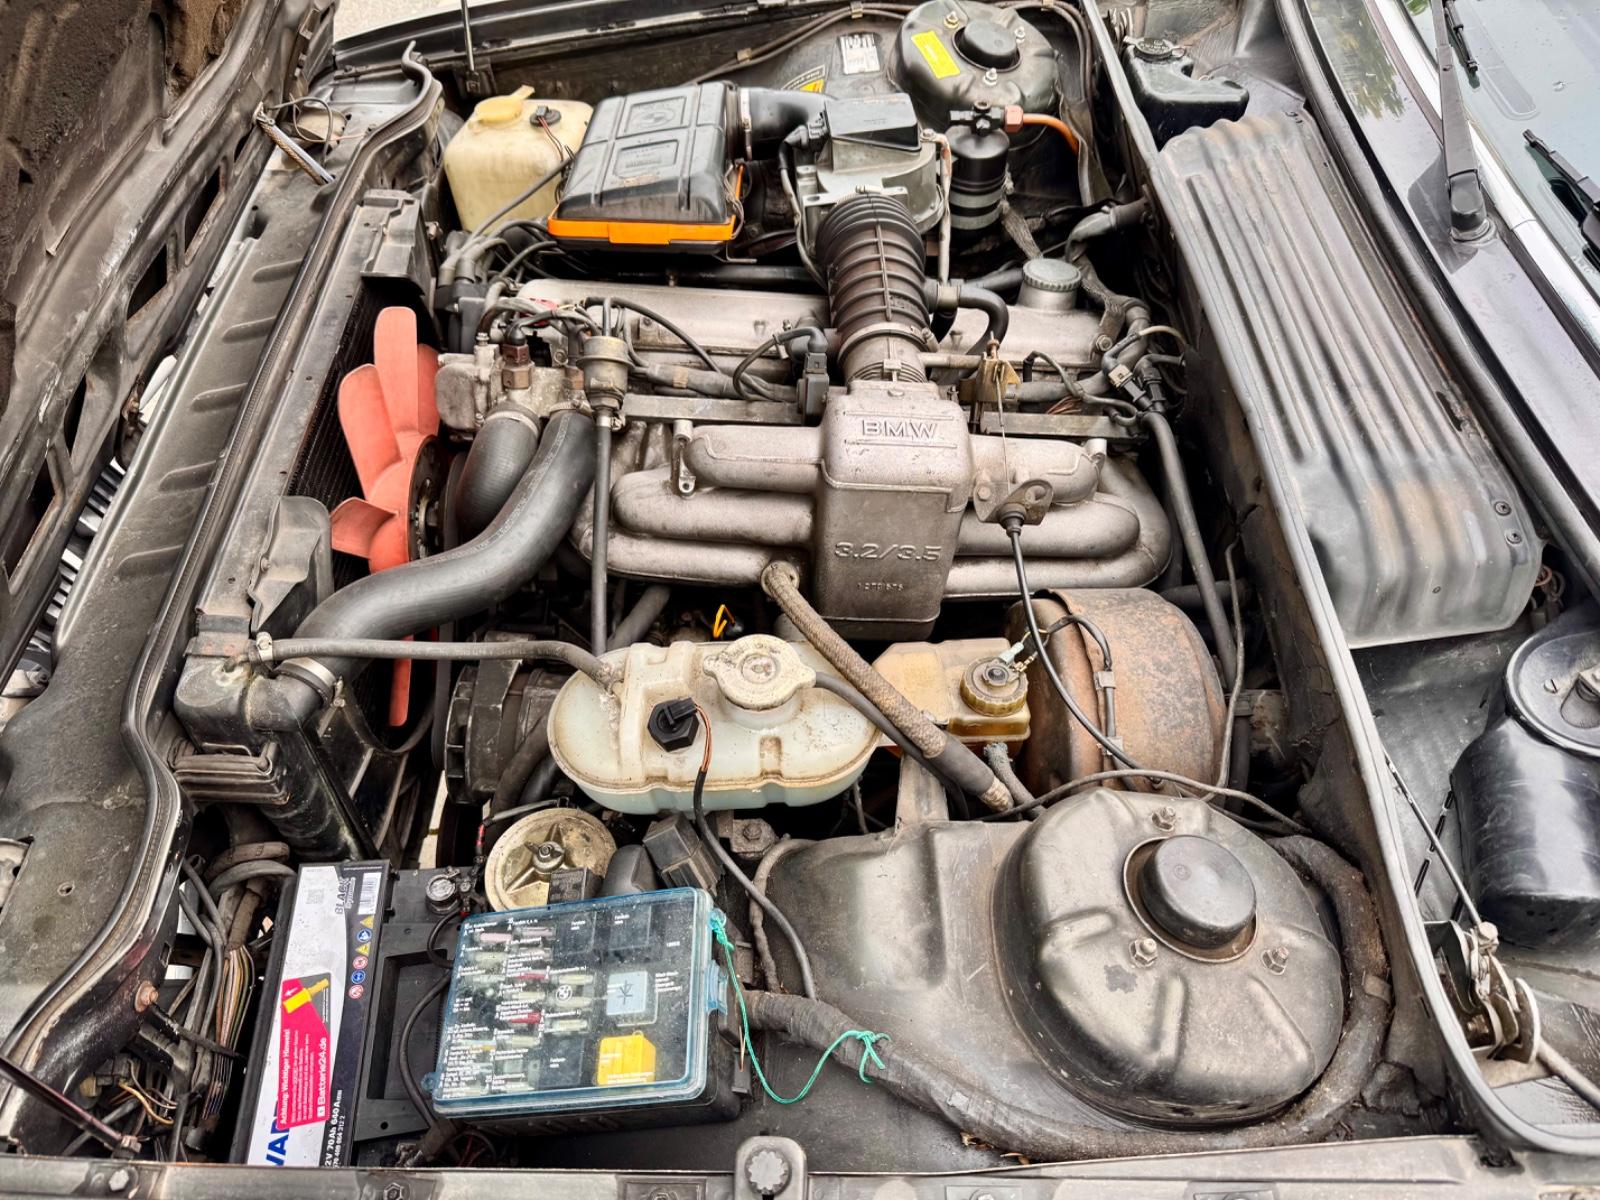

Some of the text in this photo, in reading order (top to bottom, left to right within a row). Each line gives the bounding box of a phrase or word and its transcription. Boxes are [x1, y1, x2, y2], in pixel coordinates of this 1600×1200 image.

[862, 419, 938, 440] BMW
[834, 541, 942, 561] 3.2/3.5
[335, 876, 349, 915] BLACK
[316, 1037, 327, 1104] Batterie24.de
[324, 1153, 333, 1166] 2V
